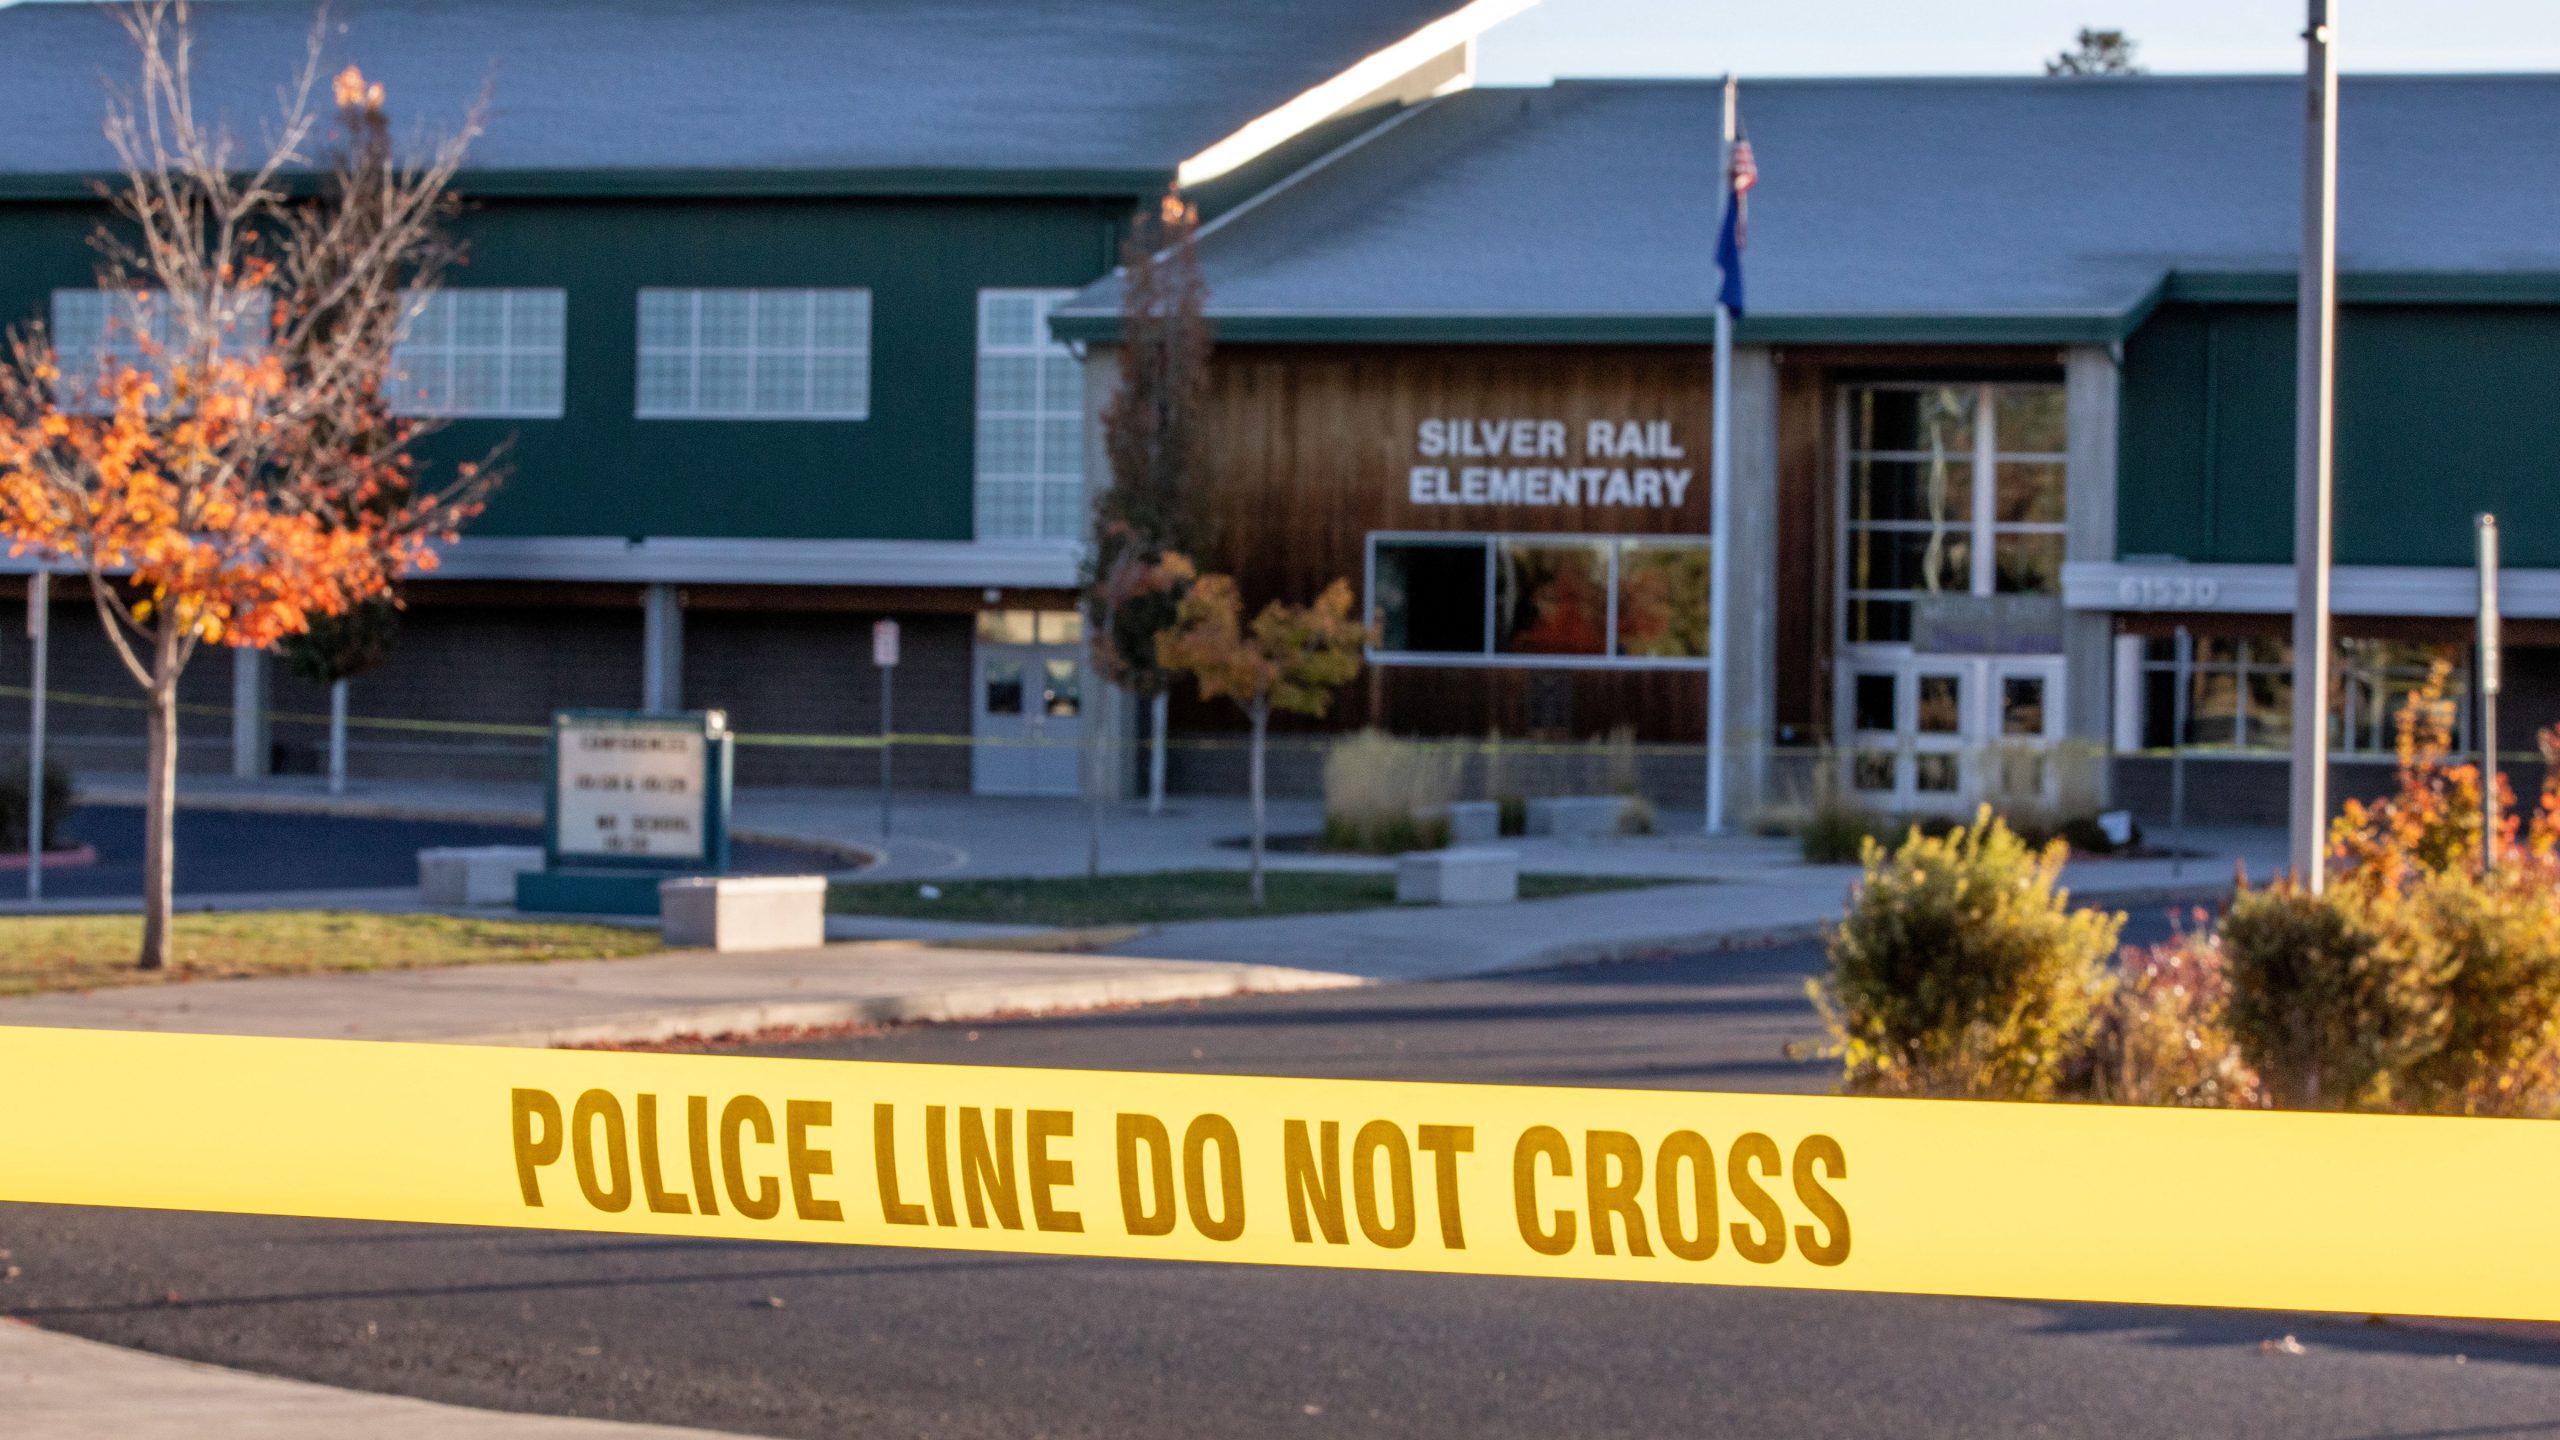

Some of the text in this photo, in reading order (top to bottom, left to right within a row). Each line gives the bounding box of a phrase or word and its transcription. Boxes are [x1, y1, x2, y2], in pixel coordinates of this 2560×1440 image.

[1418, 418, 1685, 458] SILVER RAIL
[1408, 465, 1693, 507] ELEMENTARY
[2119, 576, 2218, 605] 61530
[511, 1087, 1852, 1268] POLICE LINE DO NOT CROSS
